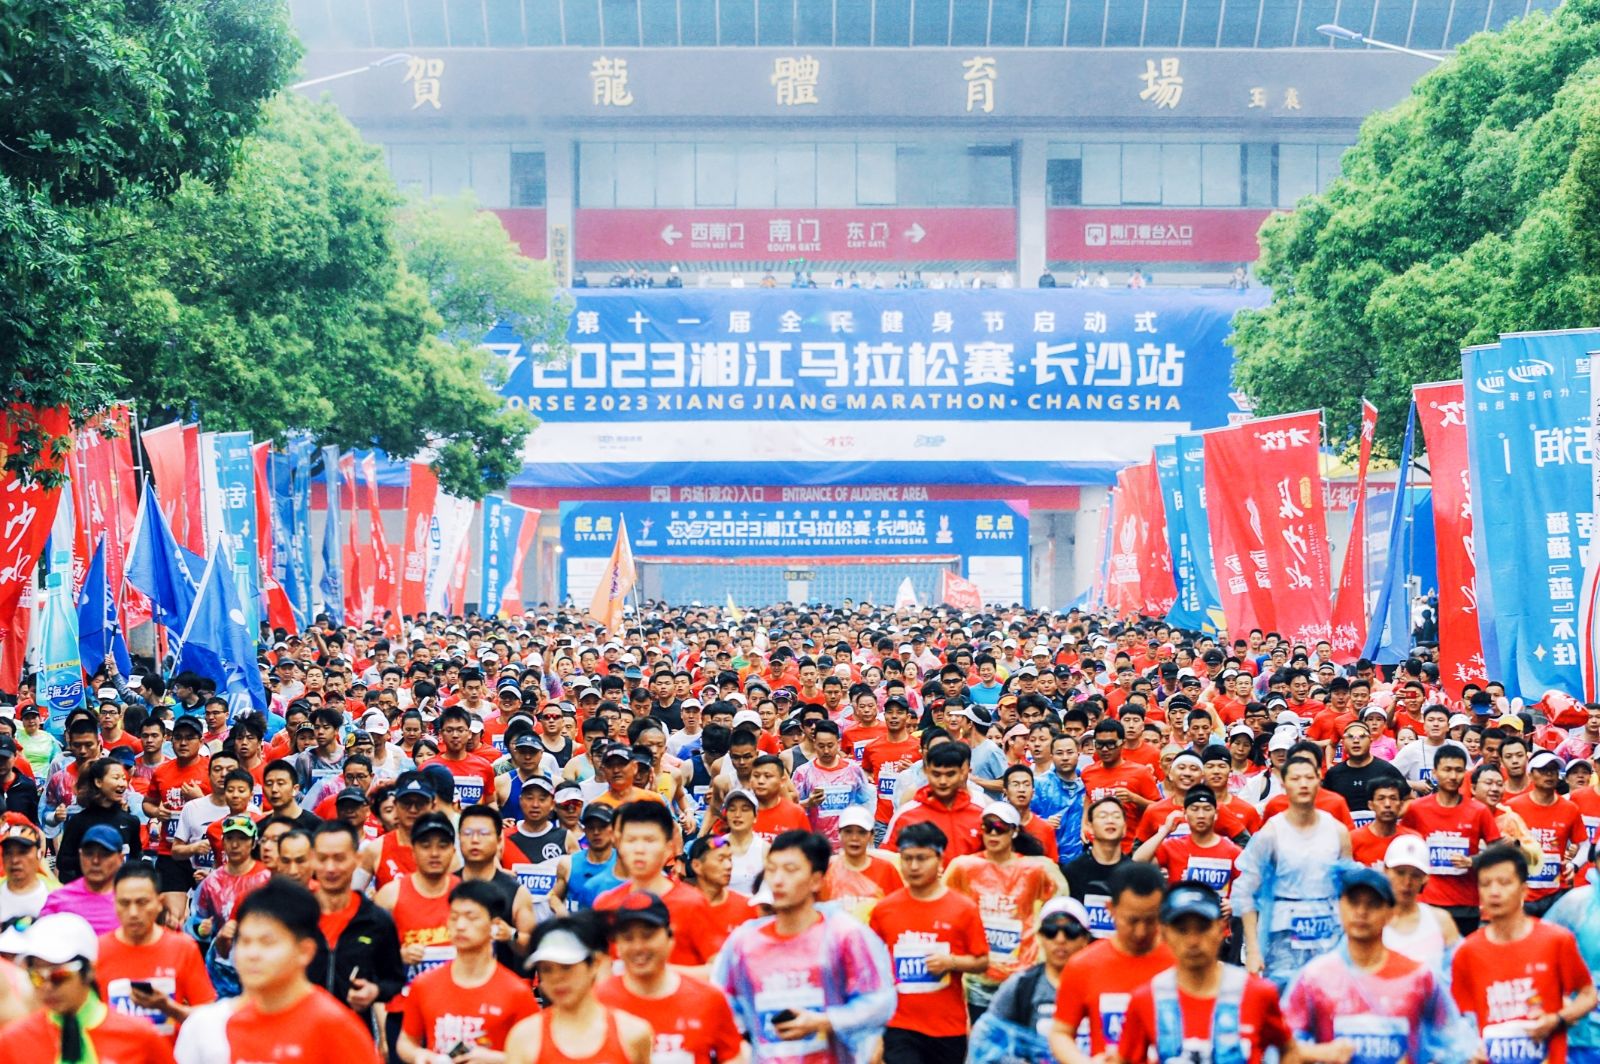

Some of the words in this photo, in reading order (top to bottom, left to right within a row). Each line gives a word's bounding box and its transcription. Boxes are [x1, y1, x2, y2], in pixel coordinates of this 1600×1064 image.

[691, 223, 745, 241] 西南门
[768, 219, 819, 242] 南门
[847, 222, 889, 241] 东门
[767, 243, 796, 252] SOUTH
[798, 243, 821, 252] GATE
[576, 310, 1158, 335] 第十一届全民健身节启动式
[507, 395, 575, 411] ORSE
[583, 395, 648, 411] 2023
[657, 394, 744, 411] XIANG
[752, 394, 837, 410] JIANG
[1027, 394, 1182, 410] CHANGSHA
[782, 487, 833, 501] ENTRANCE
[835, 487, 848, 501] OF
[850, 487, 899, 501] AUDIENCE
[901, 487, 929, 501] AREA
[575, 516, 612, 532] 起点
[976, 514, 1014, 531] 起点
[574, 533, 613, 541] START
[782, 538, 811, 546] JIANG
[976, 532, 1014, 540] START
[1191, 868, 1227, 882] A11017
